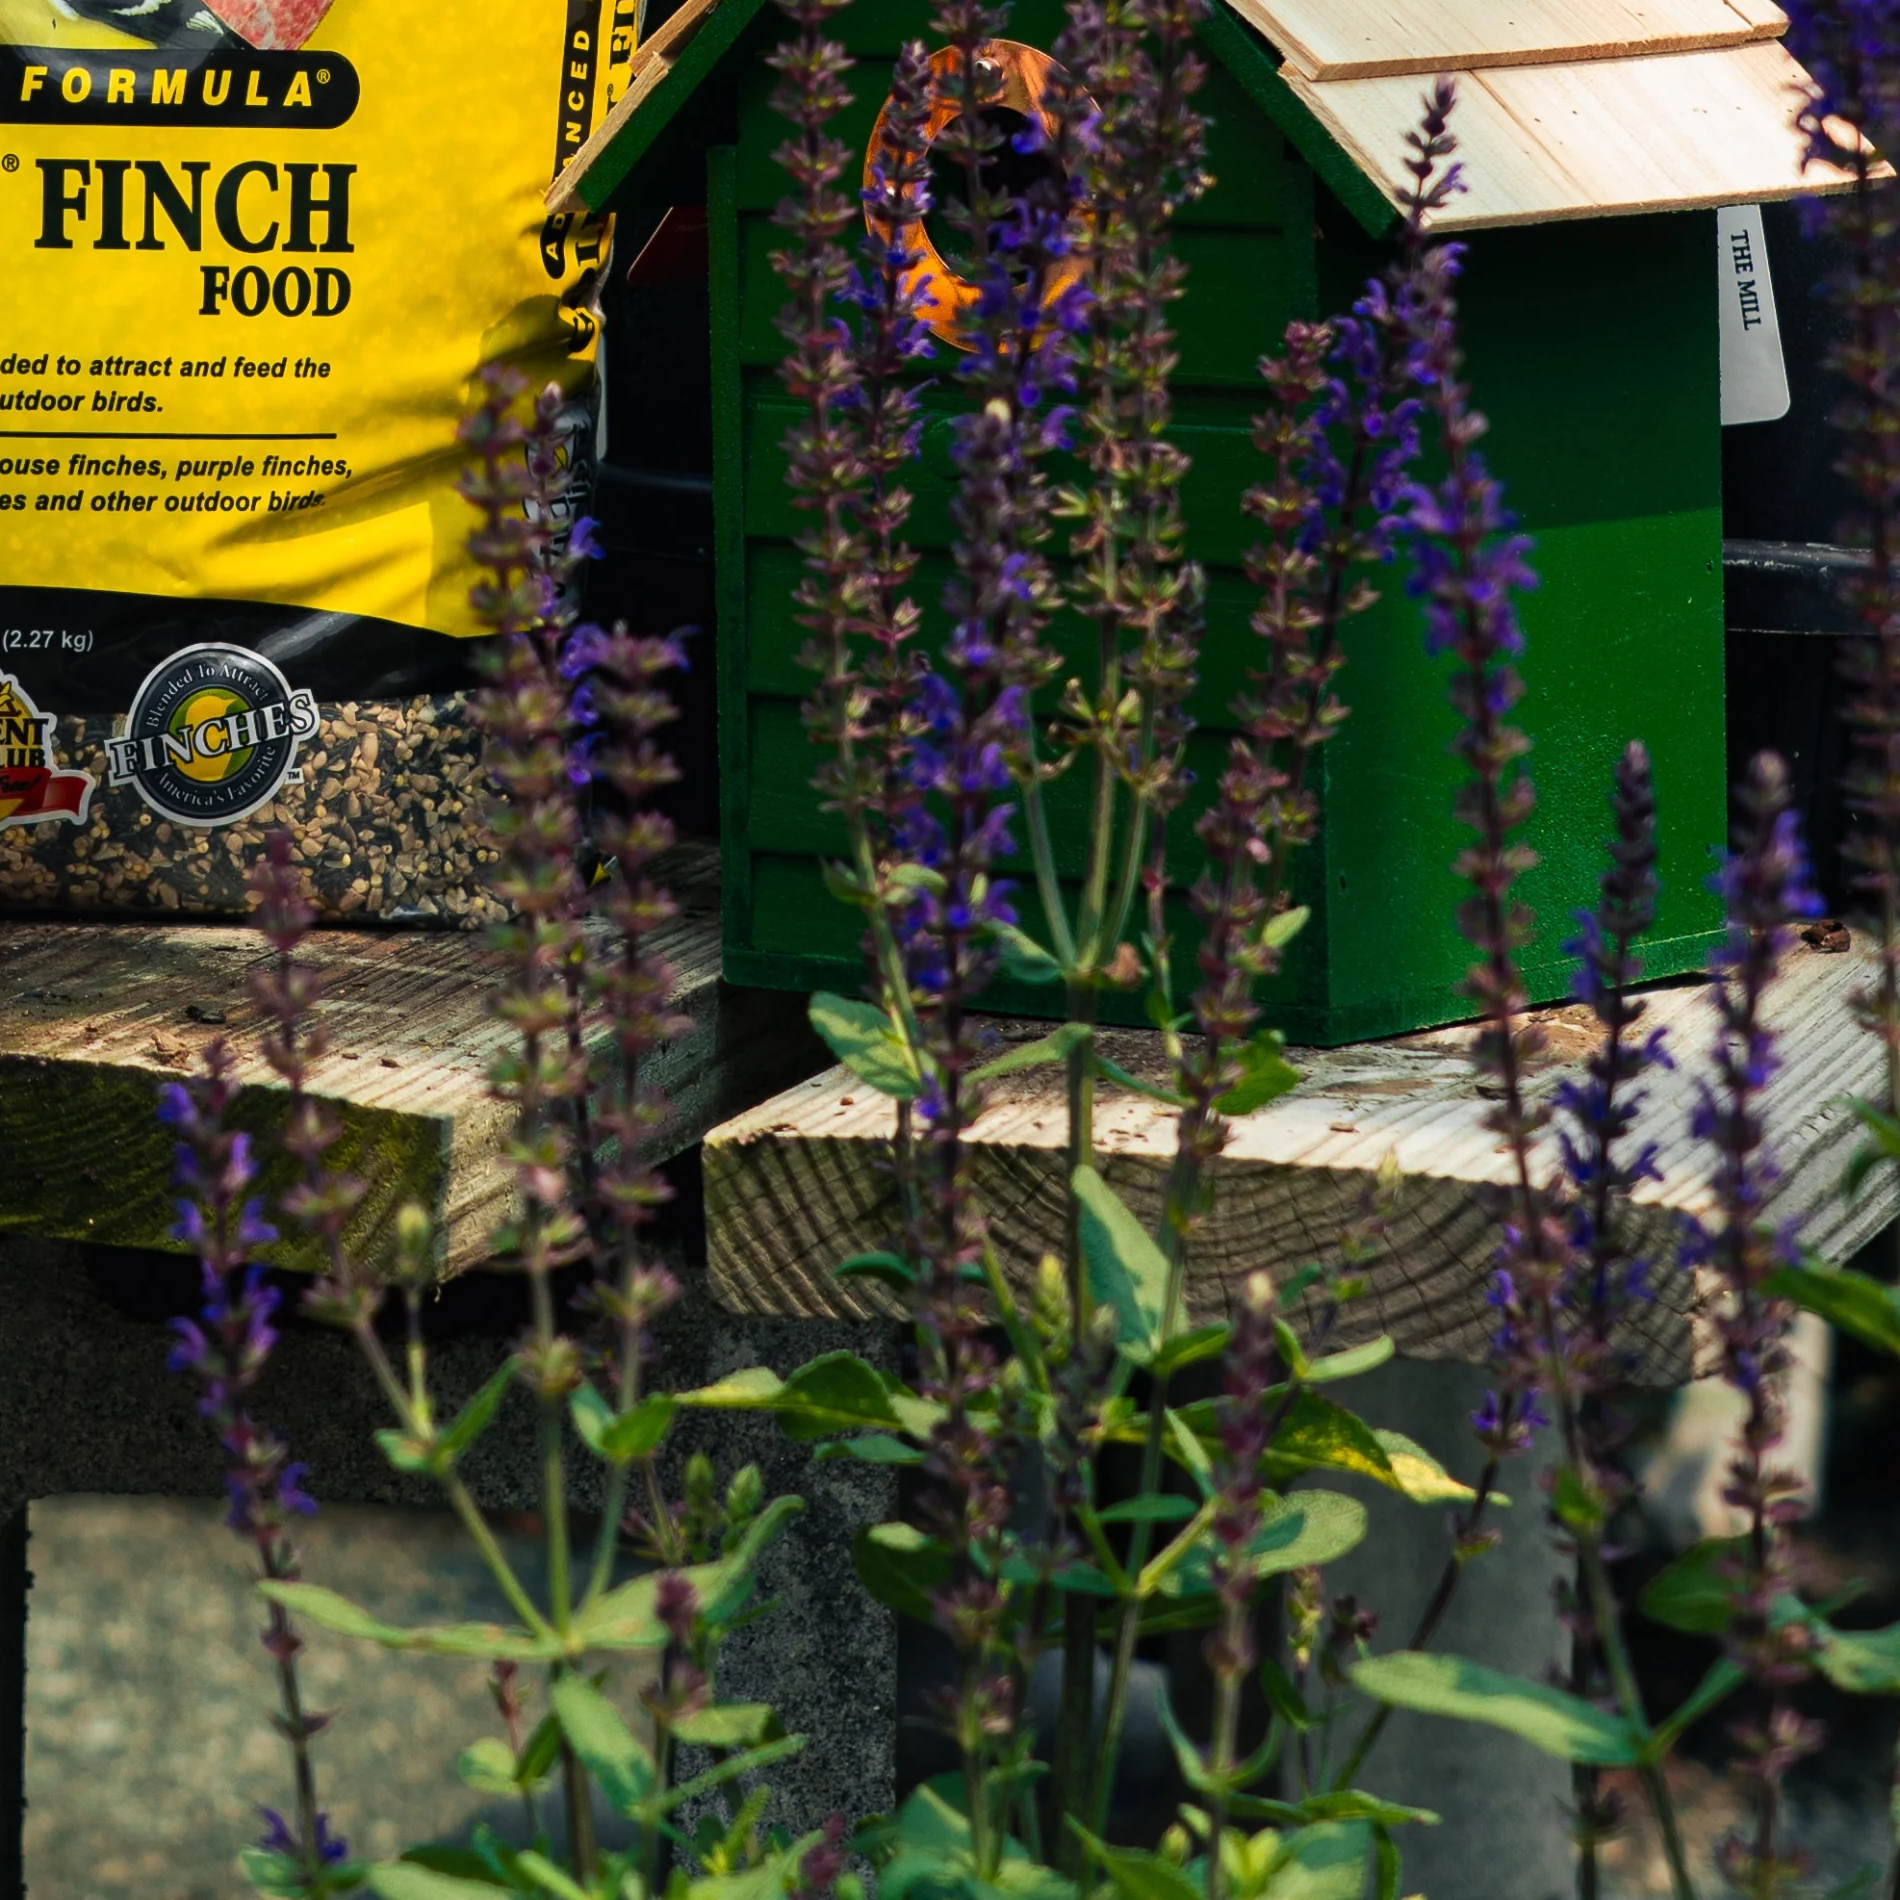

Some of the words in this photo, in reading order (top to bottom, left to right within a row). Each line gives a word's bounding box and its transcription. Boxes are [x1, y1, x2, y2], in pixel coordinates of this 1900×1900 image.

[544, 30, 591, 262] ADNCED
[34, 157, 358, 255] FINCH
[1730, 228, 1754, 275] THE
[198, 264, 352, 319] FOOD
[1737, 279, 1762, 332] MILL
[57, 355, 81, 376] to
[89, 355, 173, 378] attract
[179, 356, 227, 378] and
[233, 356, 287, 379] feed
[294, 357, 331, 379] the
[92, 390, 164, 413] birds.
[68, 453, 168, 479] finches,
[175, 455, 254, 481] purple
[261, 455, 353, 480] finches,
[35, 490, 84, 512] and
[90, 491, 158, 512] other
[164, 490, 262, 513] outdoor
[2, 629, 54, 652] (2.27
[61, 630, 93, 652] kg)
[146, 668, 193, 728] Blended
[198, 663, 216, 678] To
[219, 664, 271, 701] Attract
[112, 692, 316, 779] FINCHES
[155, 771, 226, 807] America's
[227, 745, 277, 801] Favorite
